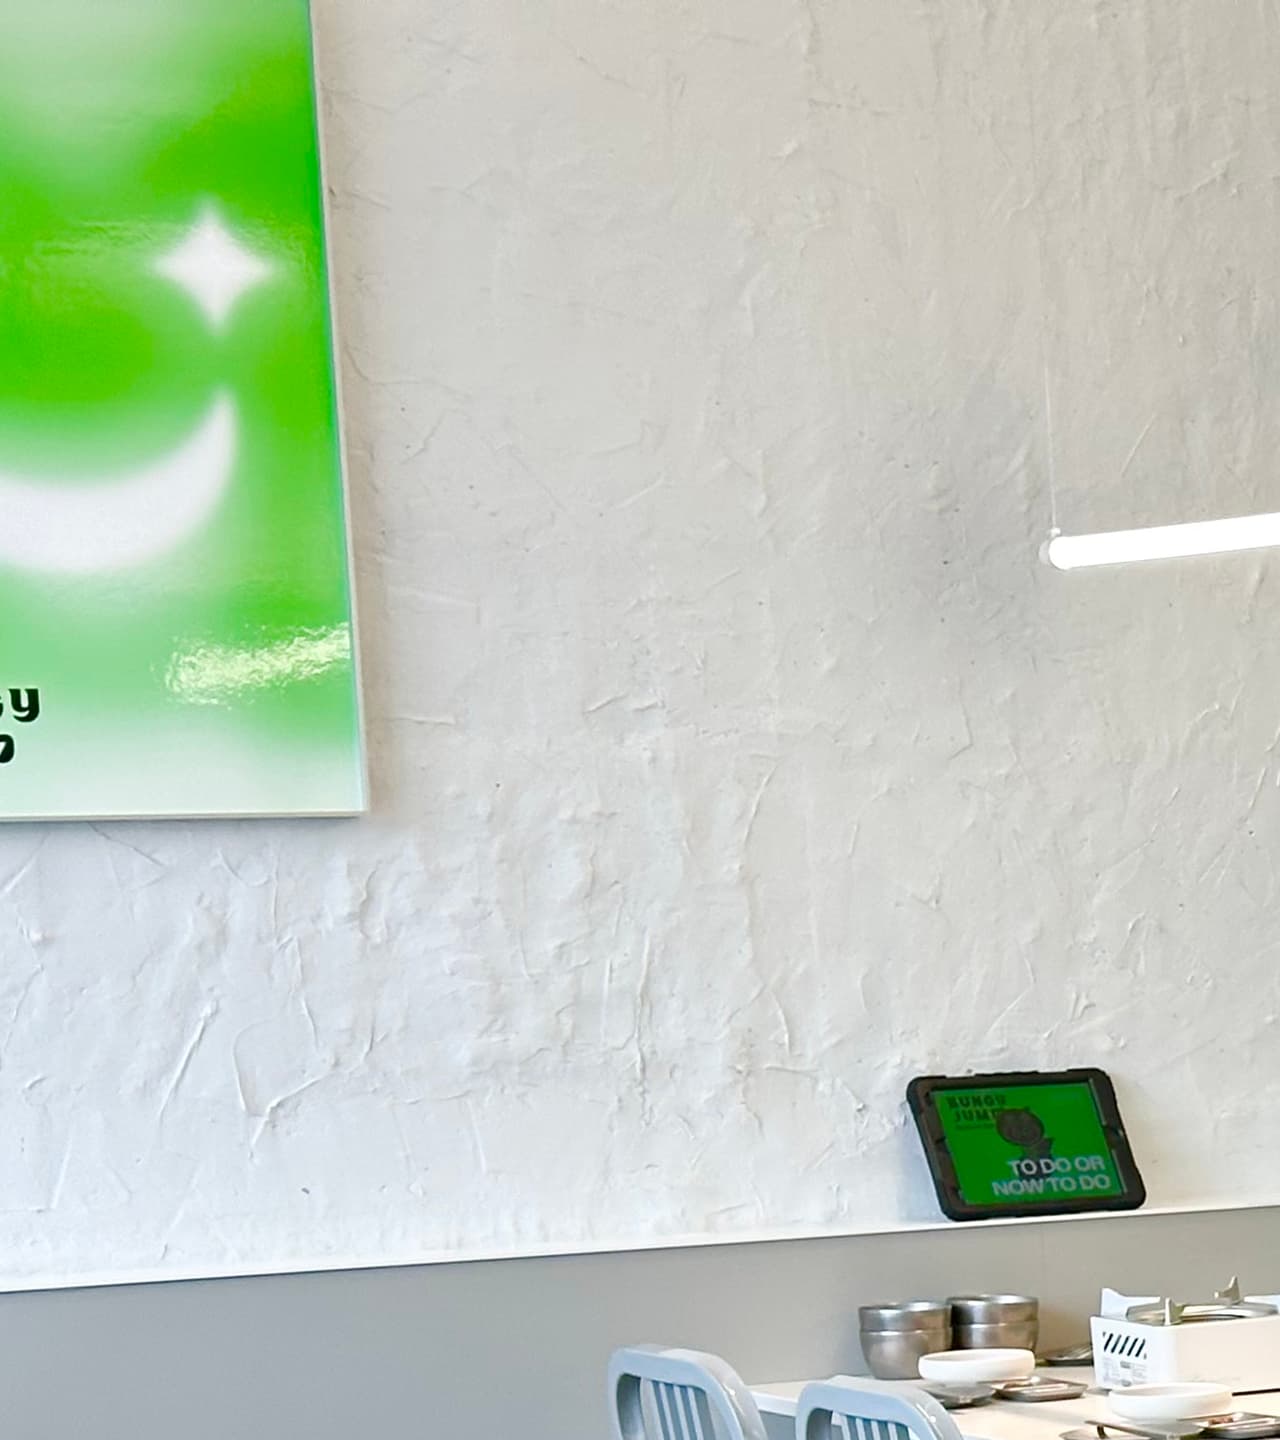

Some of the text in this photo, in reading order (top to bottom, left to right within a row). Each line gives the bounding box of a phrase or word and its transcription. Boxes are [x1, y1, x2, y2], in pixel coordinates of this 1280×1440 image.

[1006, 1155, 1106, 1176] TO DO OR
[992, 1173, 1111, 1197] NOW TO DO
